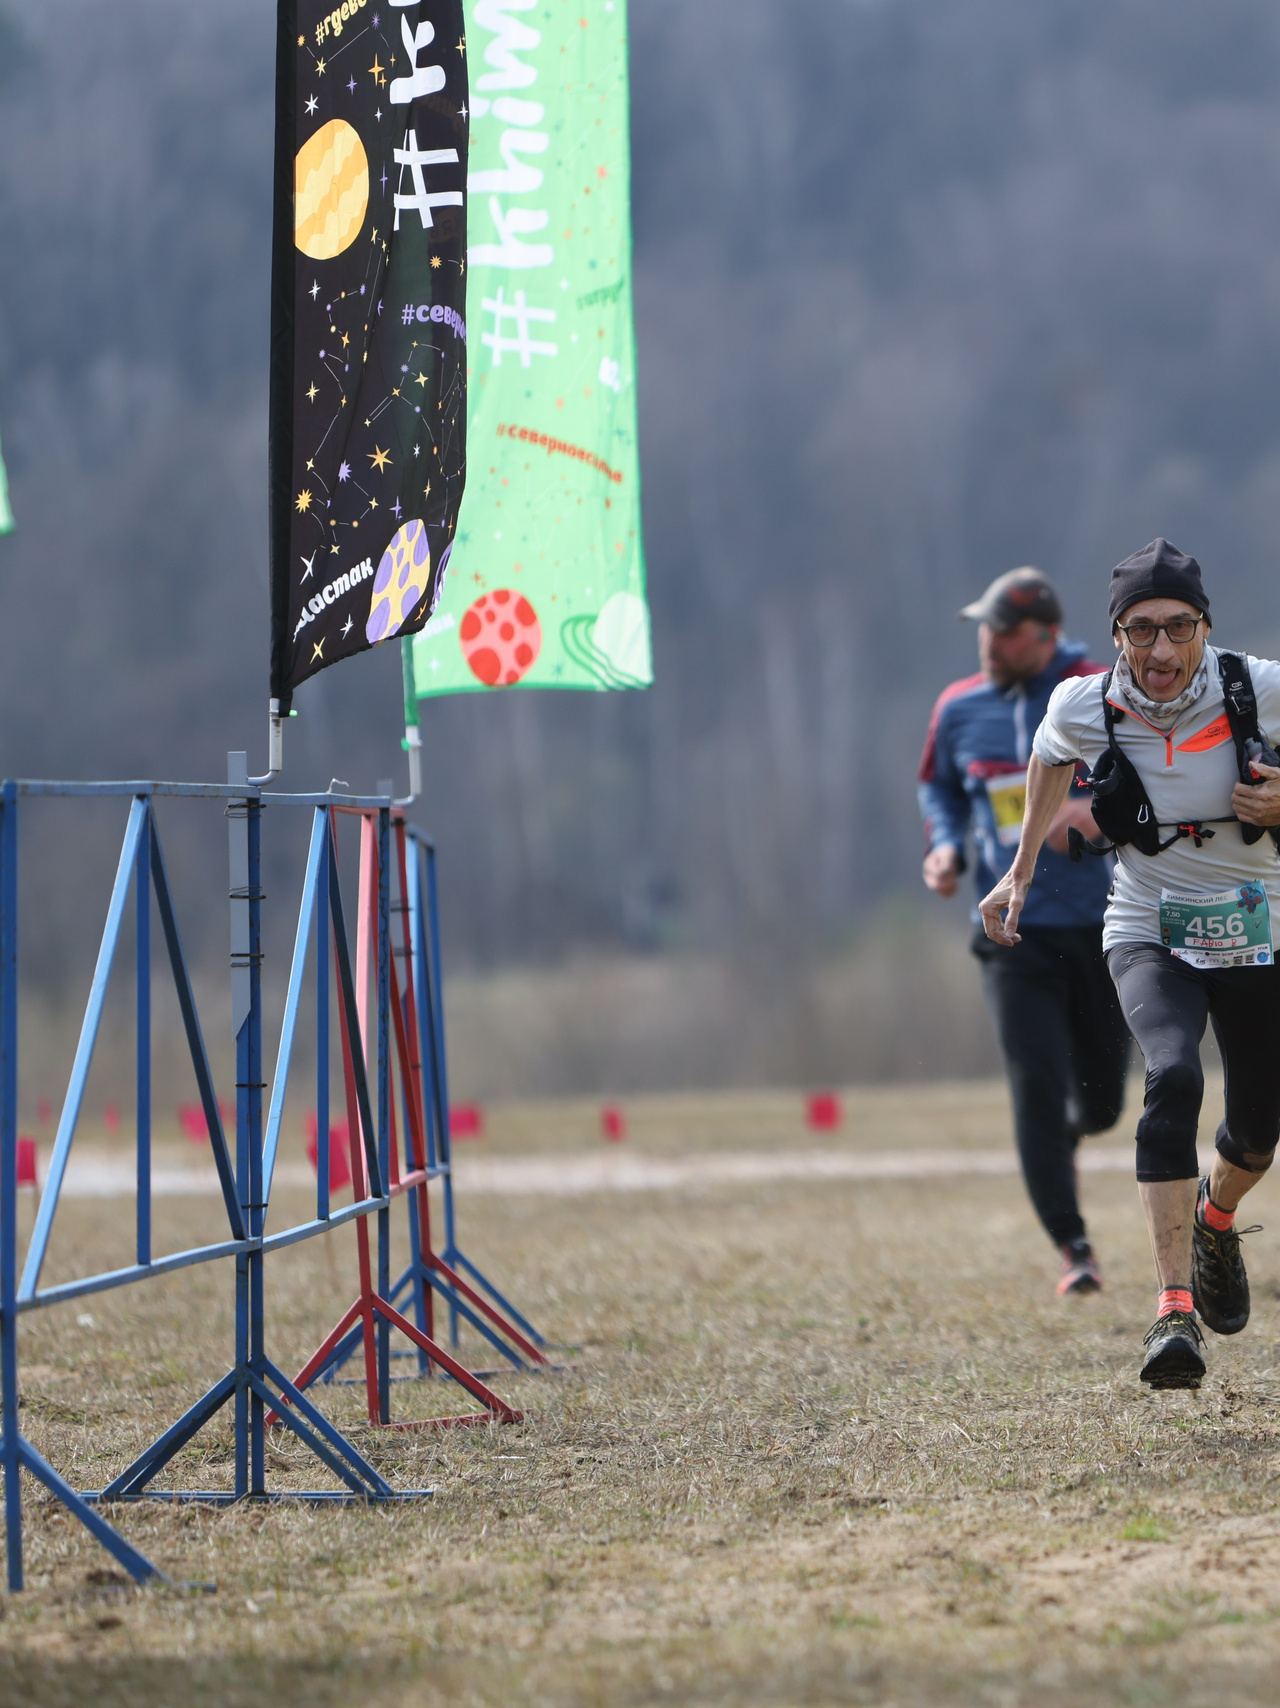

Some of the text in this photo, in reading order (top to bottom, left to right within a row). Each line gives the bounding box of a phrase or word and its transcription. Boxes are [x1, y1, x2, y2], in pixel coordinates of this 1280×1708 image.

[388, 0, 463, 231] #k
[1166, 893, 1228, 904] ХИМКИНСКИЙ ЛЕС
[1186, 912, 1245, 938] 456
